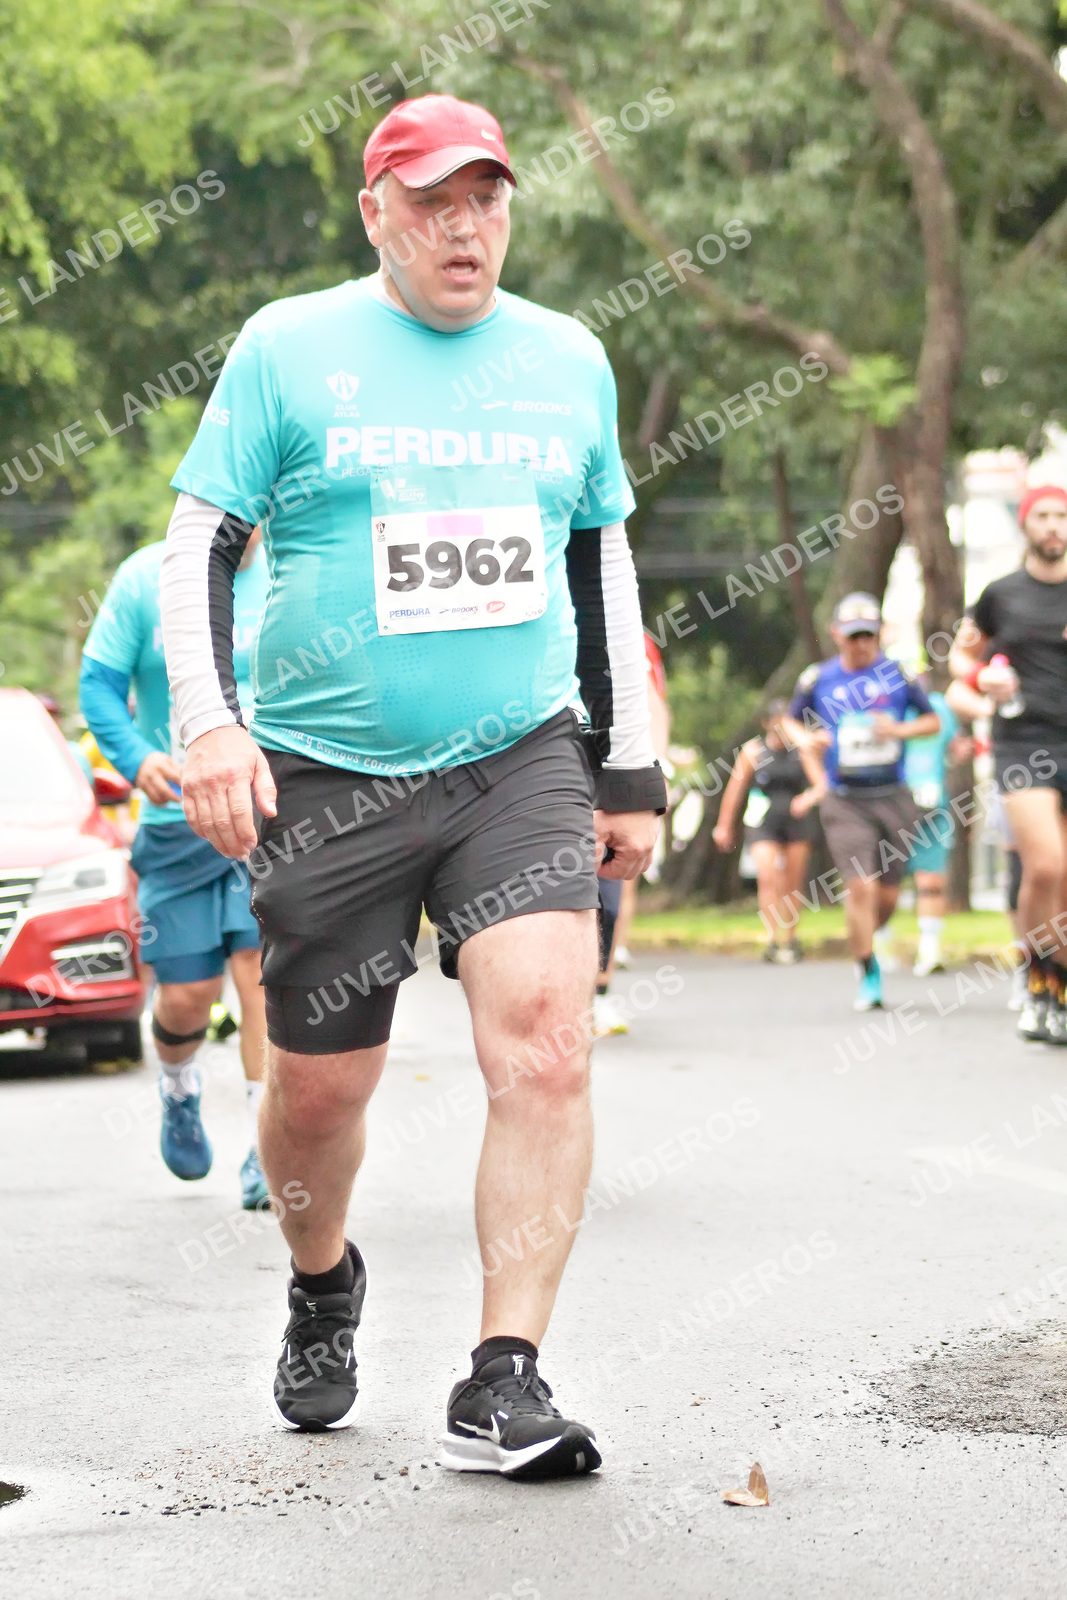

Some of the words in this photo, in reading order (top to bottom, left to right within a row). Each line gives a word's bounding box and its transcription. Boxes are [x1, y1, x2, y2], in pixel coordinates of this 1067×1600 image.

[512, 400, 572, 416] BROOKS
[326, 426, 574, 477] PERDURA
[387, 536, 534, 592] 5962
[389, 607, 431, 619] PERDURA
